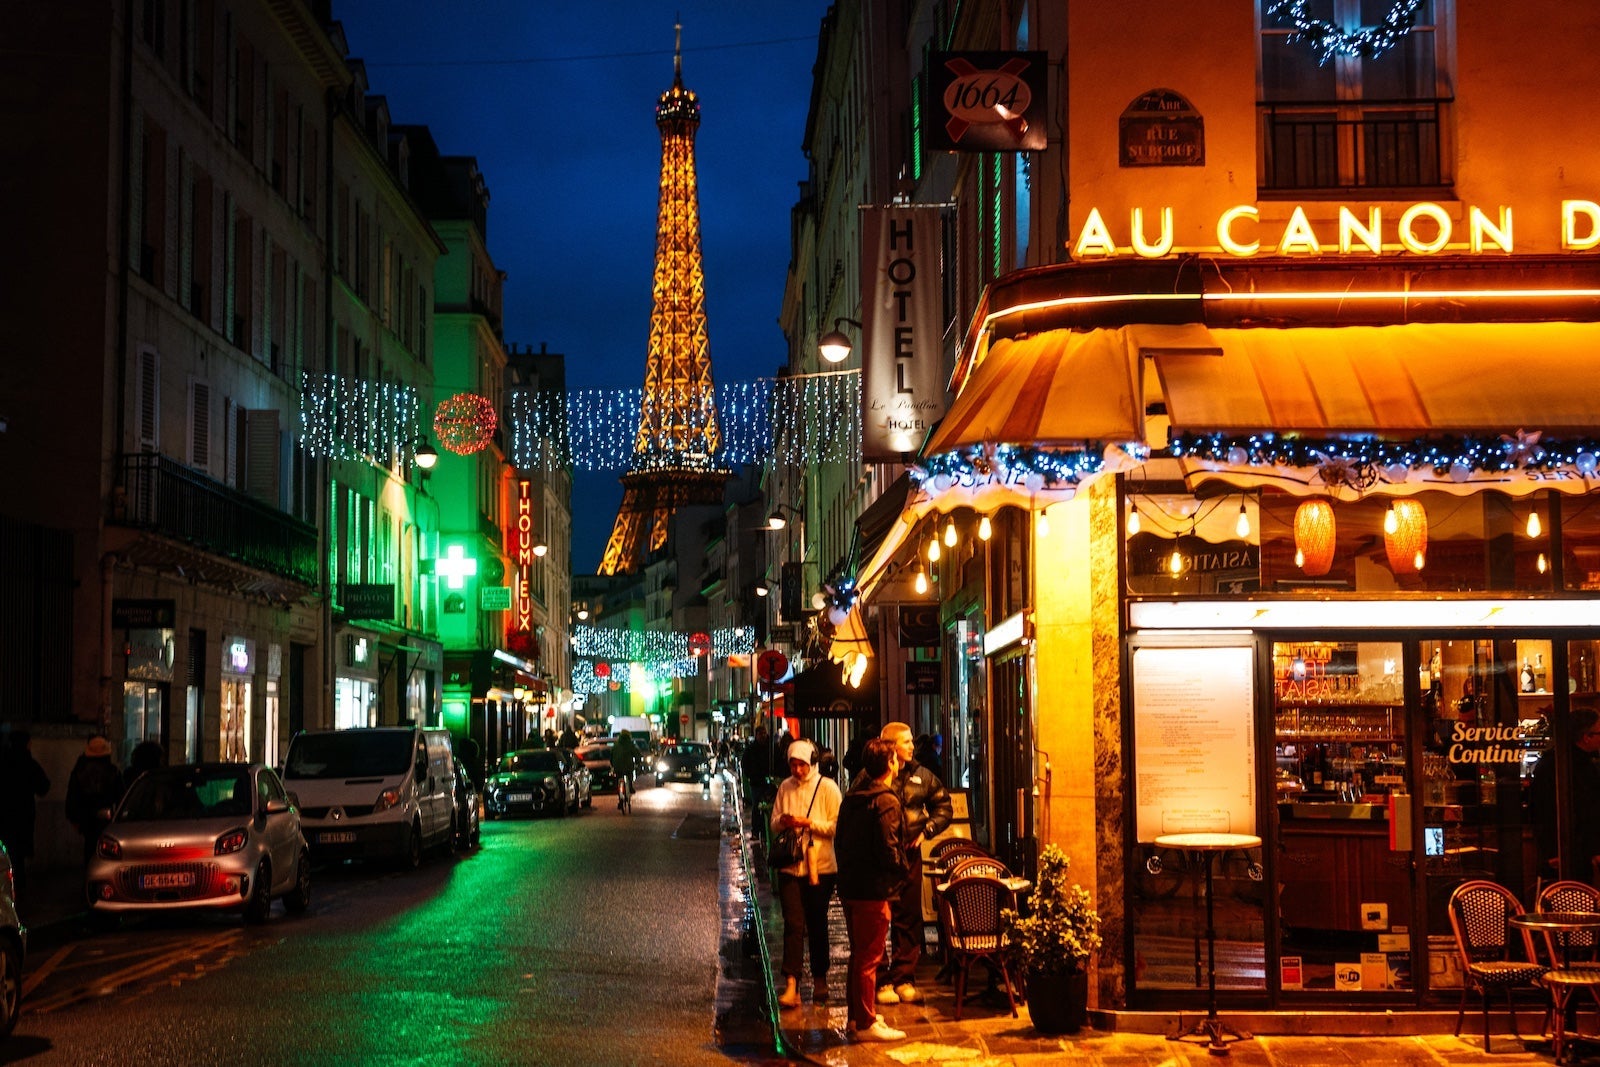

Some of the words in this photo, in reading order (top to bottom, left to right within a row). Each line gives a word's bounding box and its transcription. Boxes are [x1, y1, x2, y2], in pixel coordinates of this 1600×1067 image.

[951, 77, 1021, 110] 1664
[1146, 129, 1178, 140] RUE
[1129, 145, 1195, 157] SURCOUF
[1072, 206, 1176, 258] AU
[1217, 202, 1514, 257] CANON
[888, 219, 916, 394] HOTEL
[870, 399, 886, 411] Le
[889, 419, 926, 430] HOTEL
[518, 481, 531, 632] THOUMIEUX
[1451, 721, 1522, 742] Service
